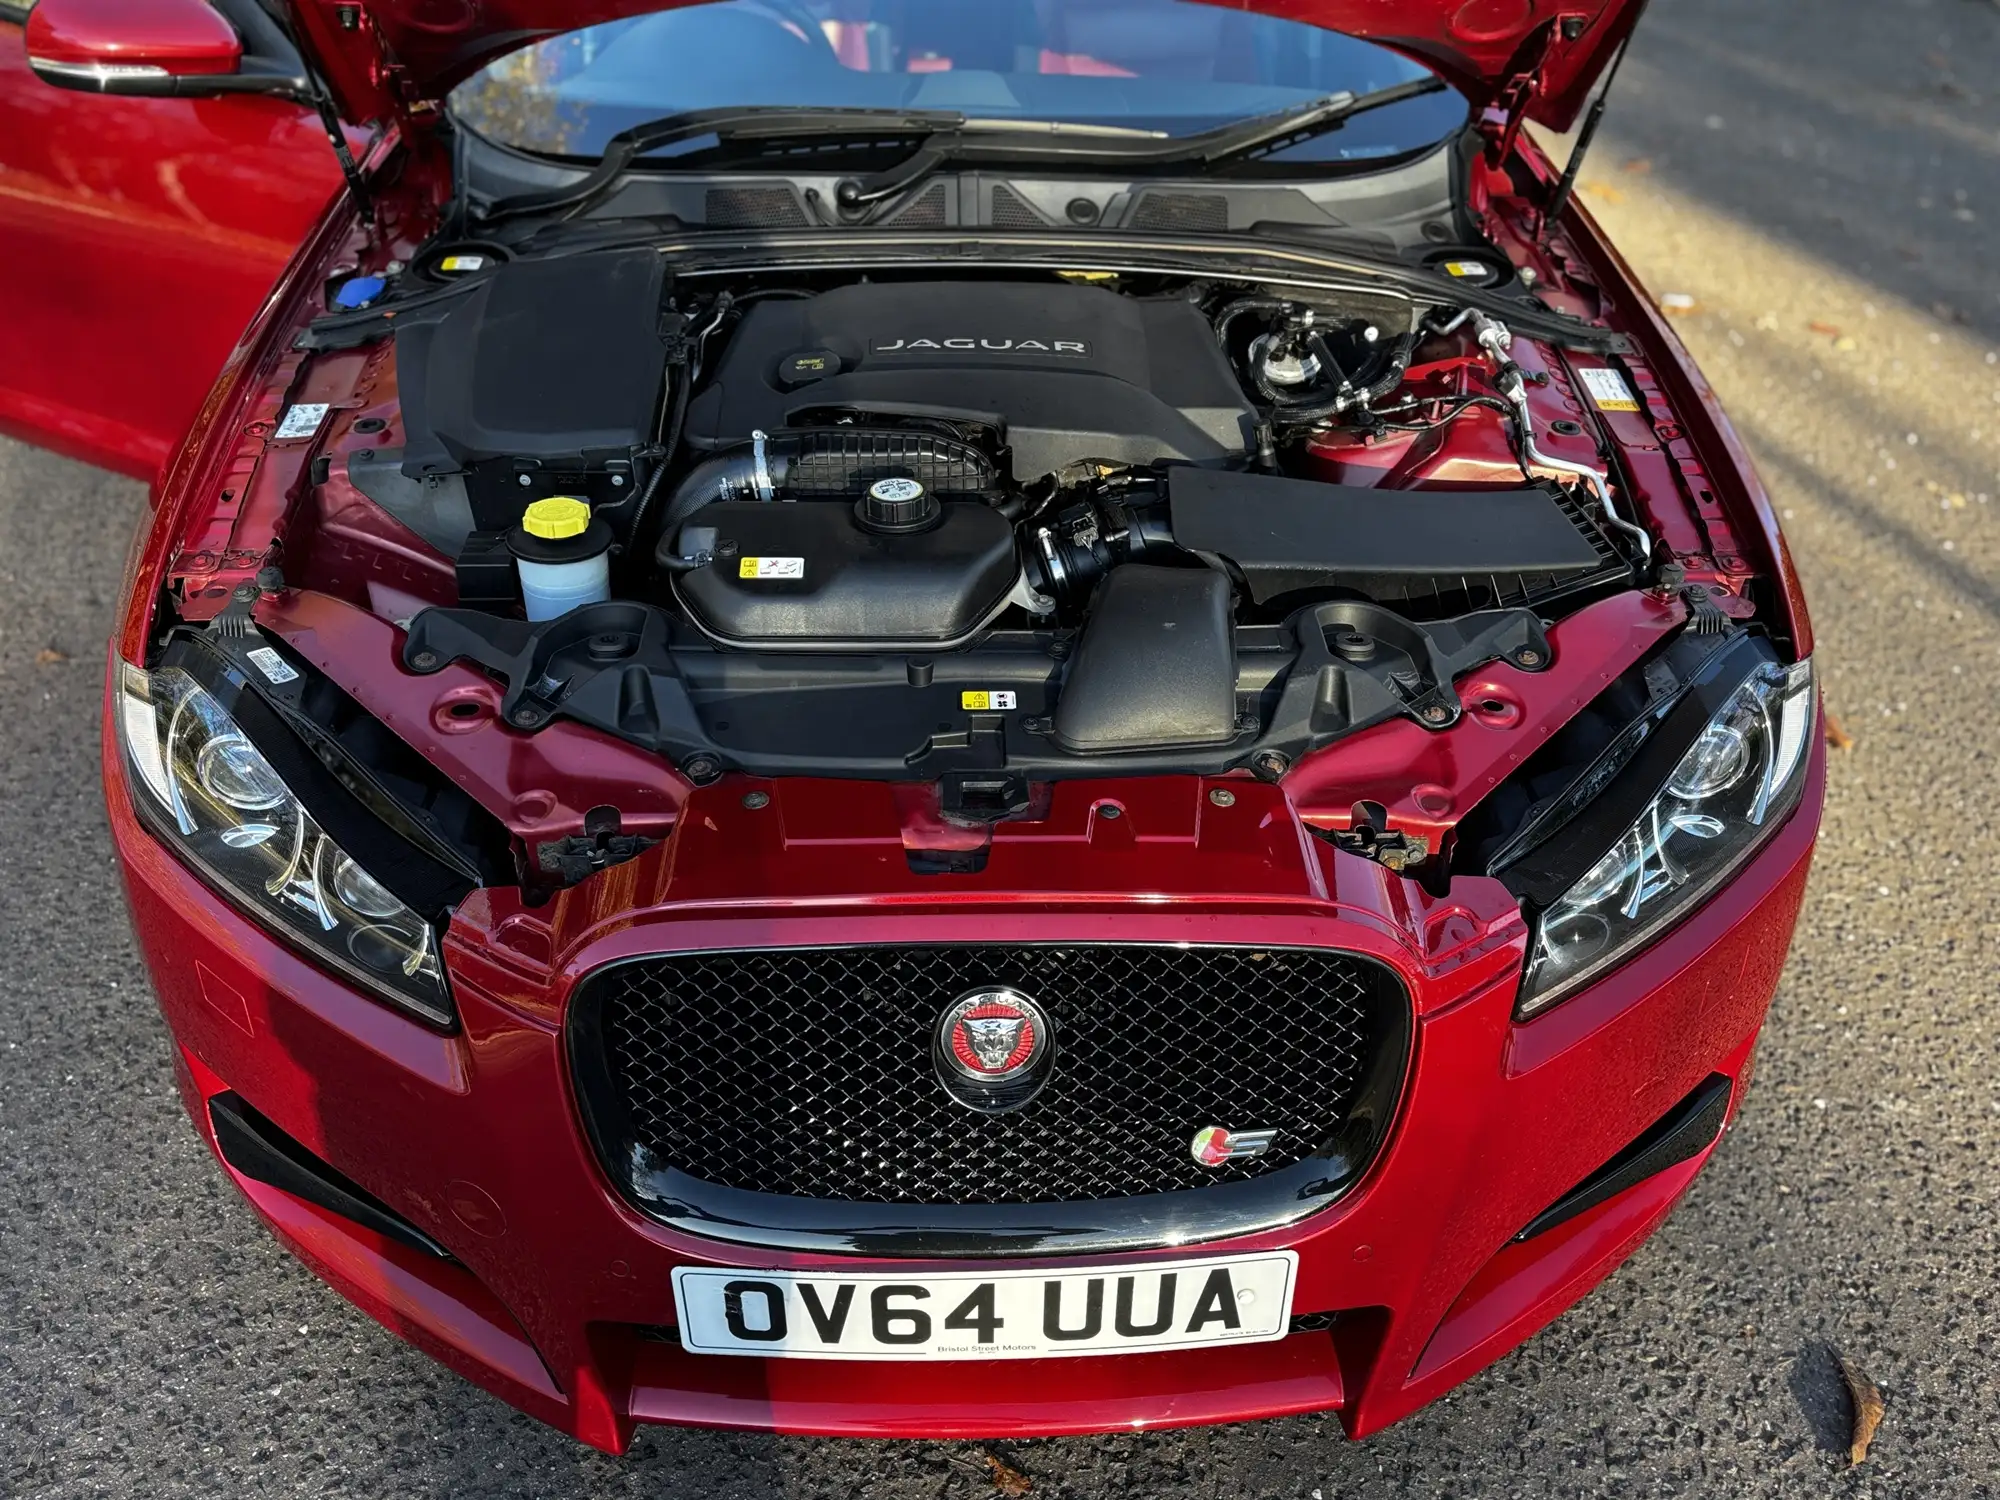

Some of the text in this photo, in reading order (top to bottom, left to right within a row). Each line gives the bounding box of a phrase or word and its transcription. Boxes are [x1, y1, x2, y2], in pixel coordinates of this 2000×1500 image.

[876, 338, 1085, 353] JAGUAR
[953, 992, 1036, 1022] JAGUAR
[723, 1268, 1241, 1345] OV64 UUA
